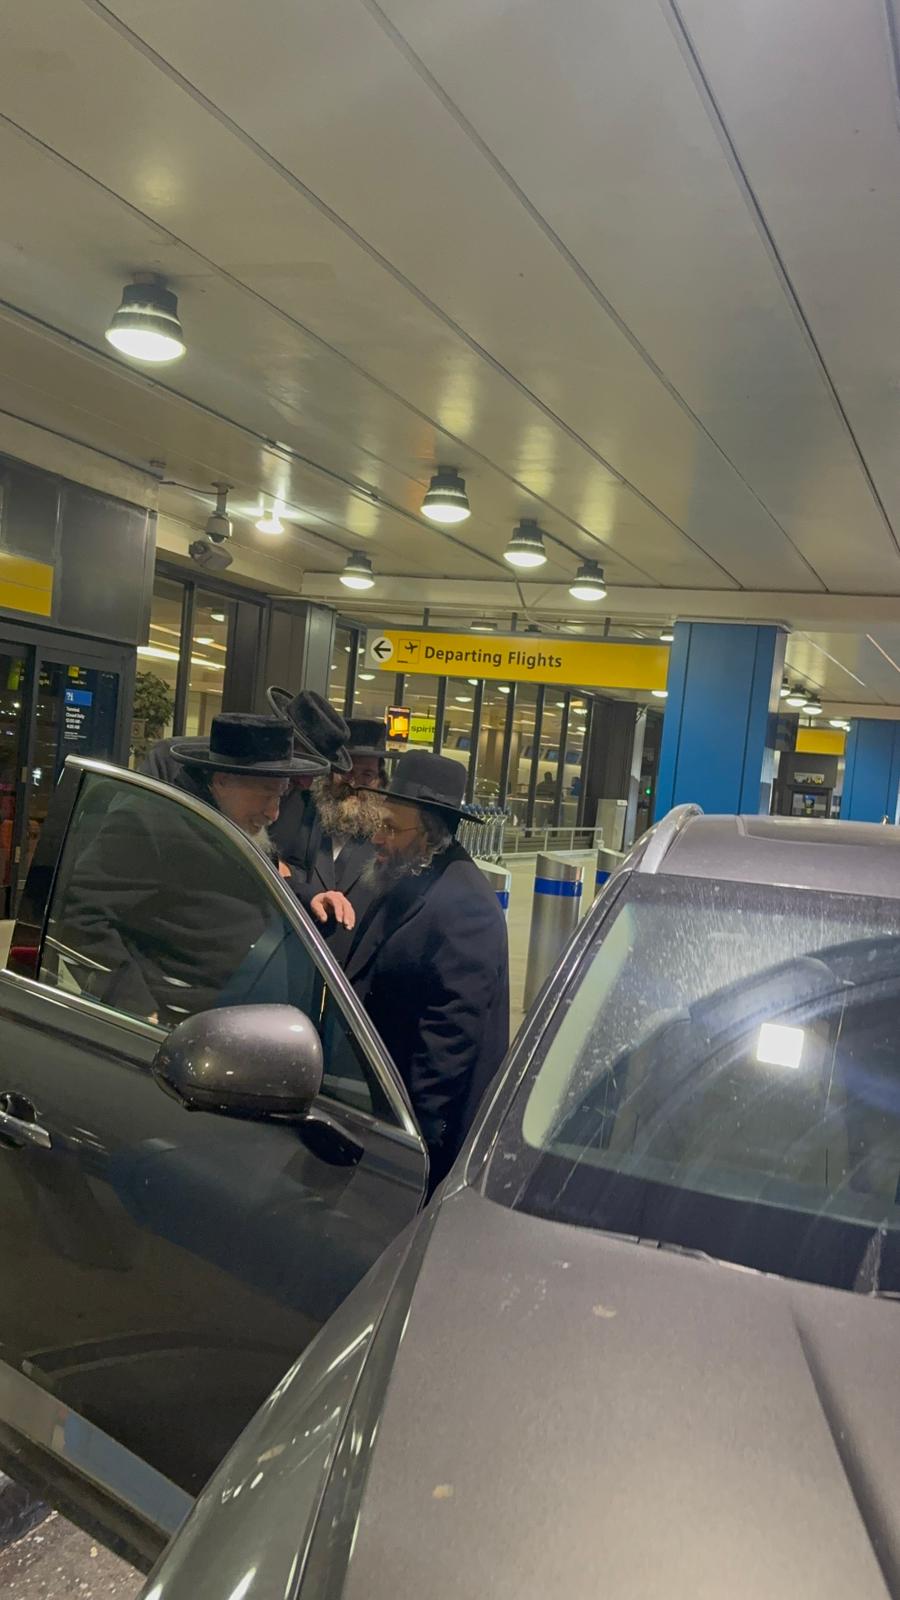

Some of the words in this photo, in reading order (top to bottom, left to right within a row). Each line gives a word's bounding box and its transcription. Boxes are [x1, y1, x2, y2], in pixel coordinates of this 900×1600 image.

[425, 646, 502, 667] Departing
[508, 651, 562, 669] Flights
[411, 725, 436, 733] spirit
